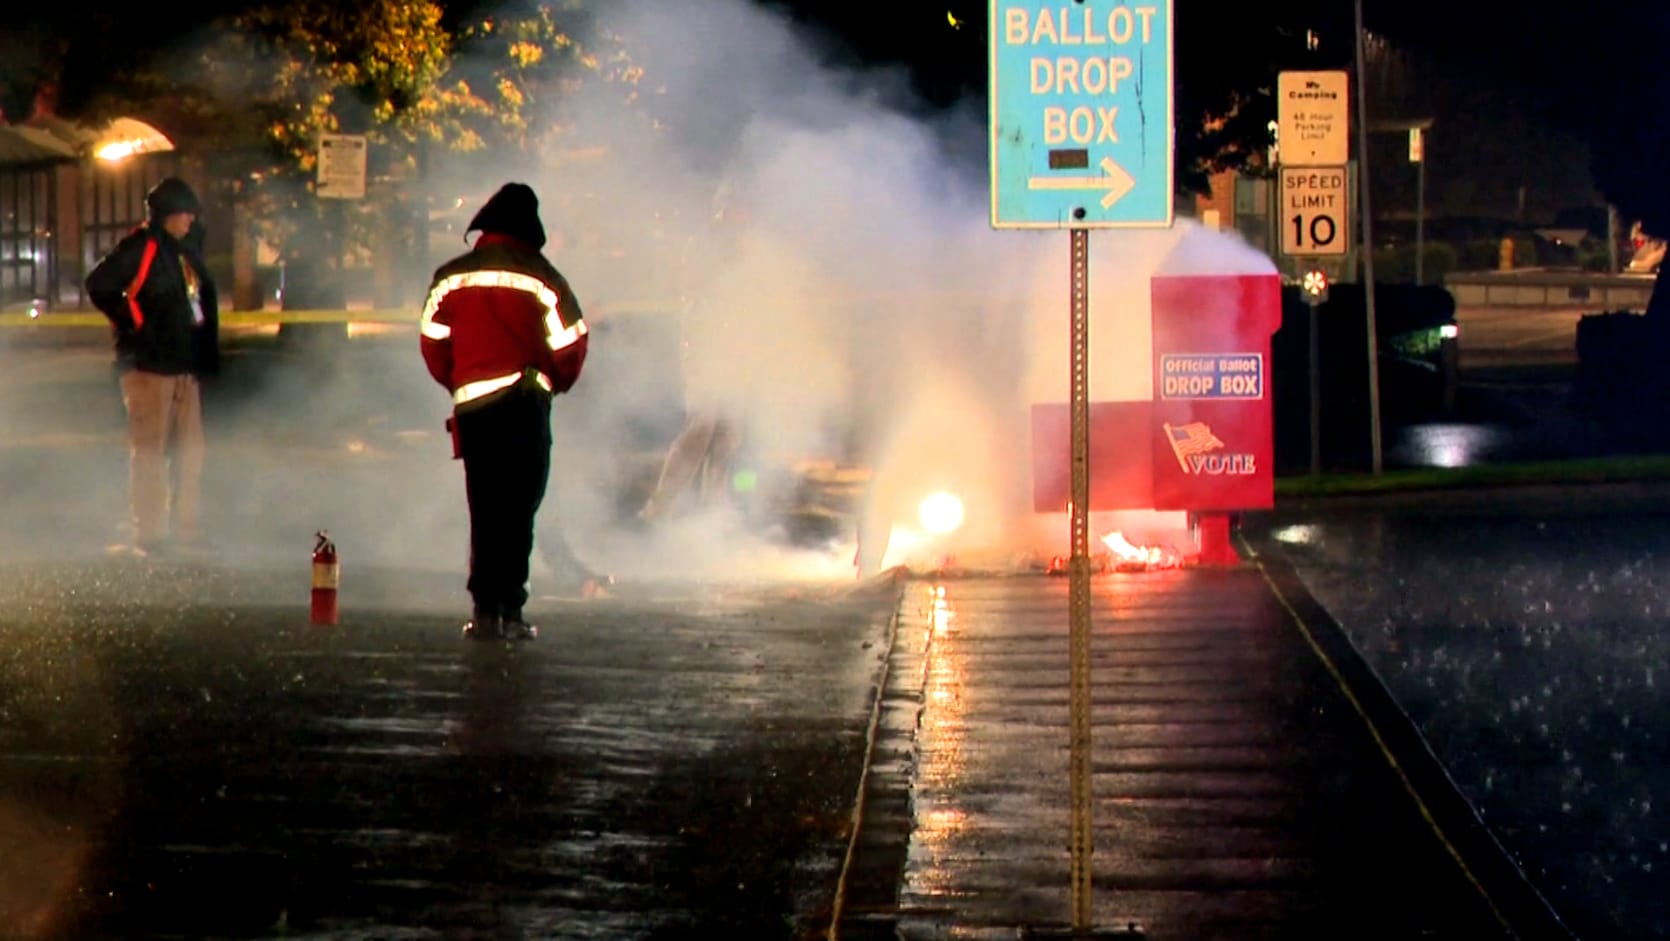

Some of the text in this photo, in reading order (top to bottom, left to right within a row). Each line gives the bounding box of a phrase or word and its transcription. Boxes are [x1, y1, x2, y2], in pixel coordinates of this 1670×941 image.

[1005, 6, 1157, 45] BALLOT
[1030, 56, 1134, 95] DROP
[1289, 91, 1337, 100] Camping
[1043, 106, 1120, 145] BOX
[1286, 175, 1341, 189] SPEED
[1291, 194, 1335, 208] LIMIT
[1291, 213, 1336, 247] 10
[1165, 358, 1257, 373] Official Ballot
[1164, 374, 1258, 395] DROP BOX
[1187, 453, 1256, 475] VOTE
